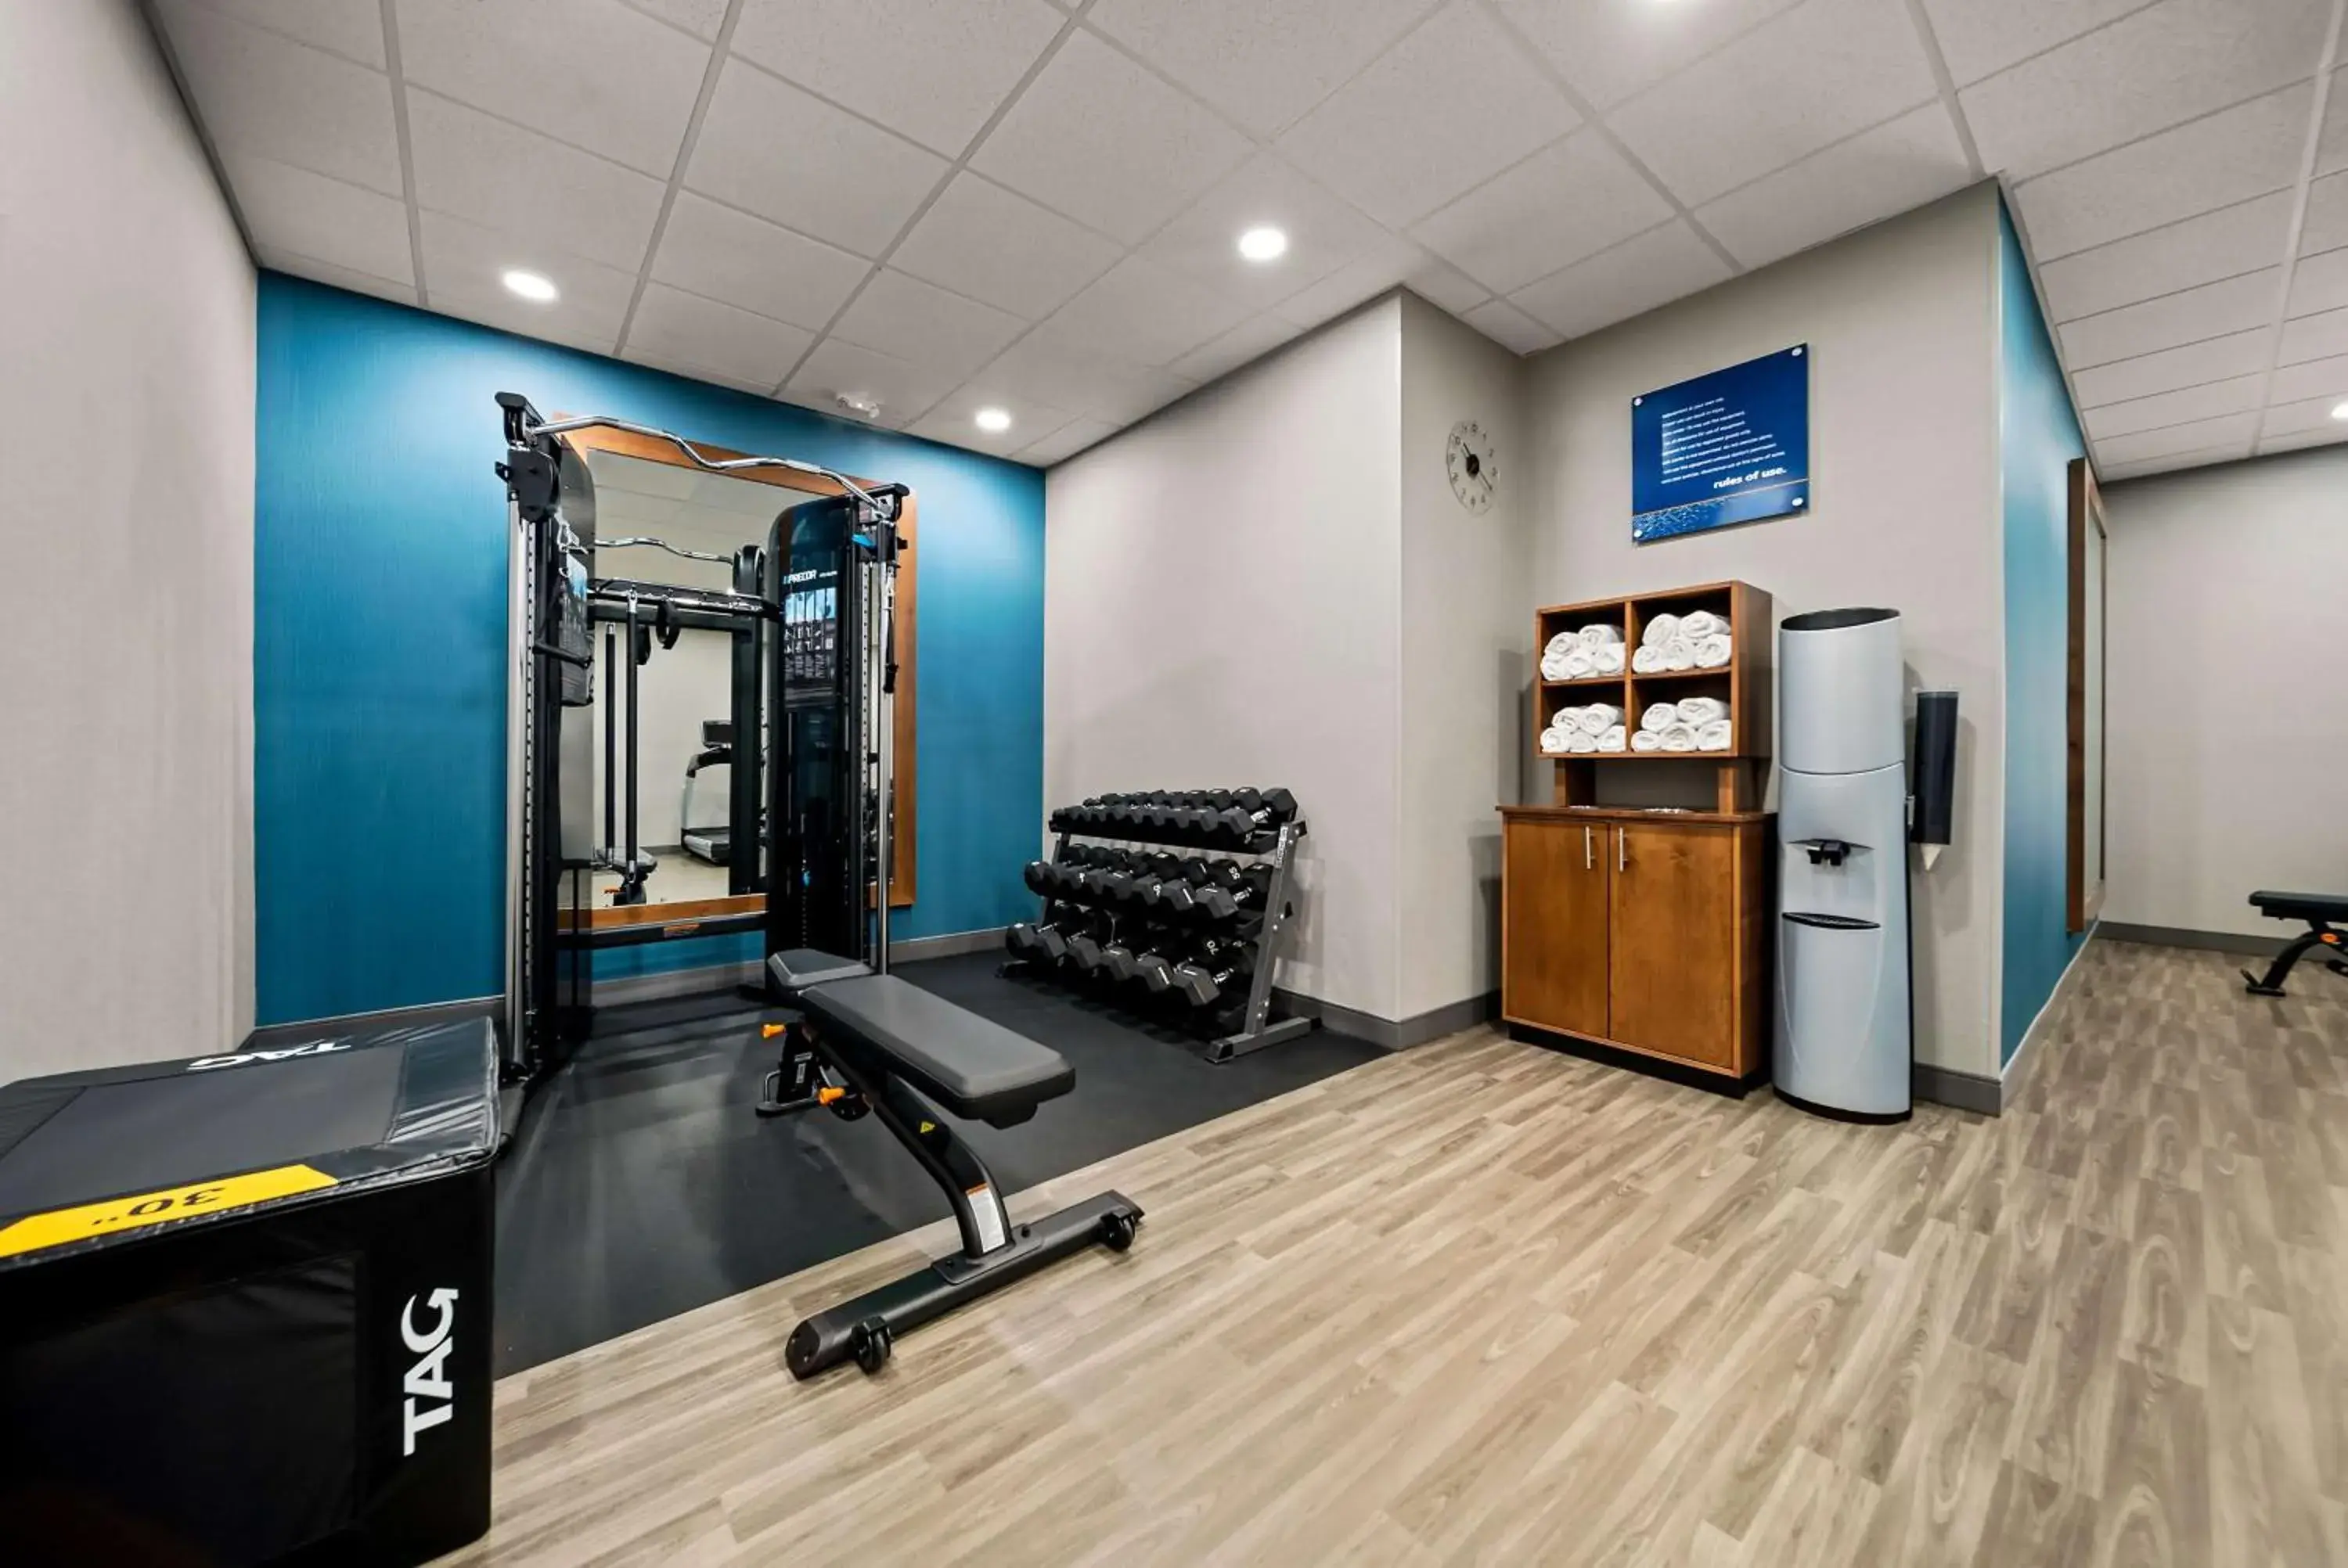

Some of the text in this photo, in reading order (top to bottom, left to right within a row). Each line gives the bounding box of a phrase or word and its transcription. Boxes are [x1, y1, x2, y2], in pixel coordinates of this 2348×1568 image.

[1713, 477, 1743, 489] rules
[1745, 469, 1760, 482] of
[185, 1038, 351, 1072] TAG
[401, 1287, 459, 1457] TAG
